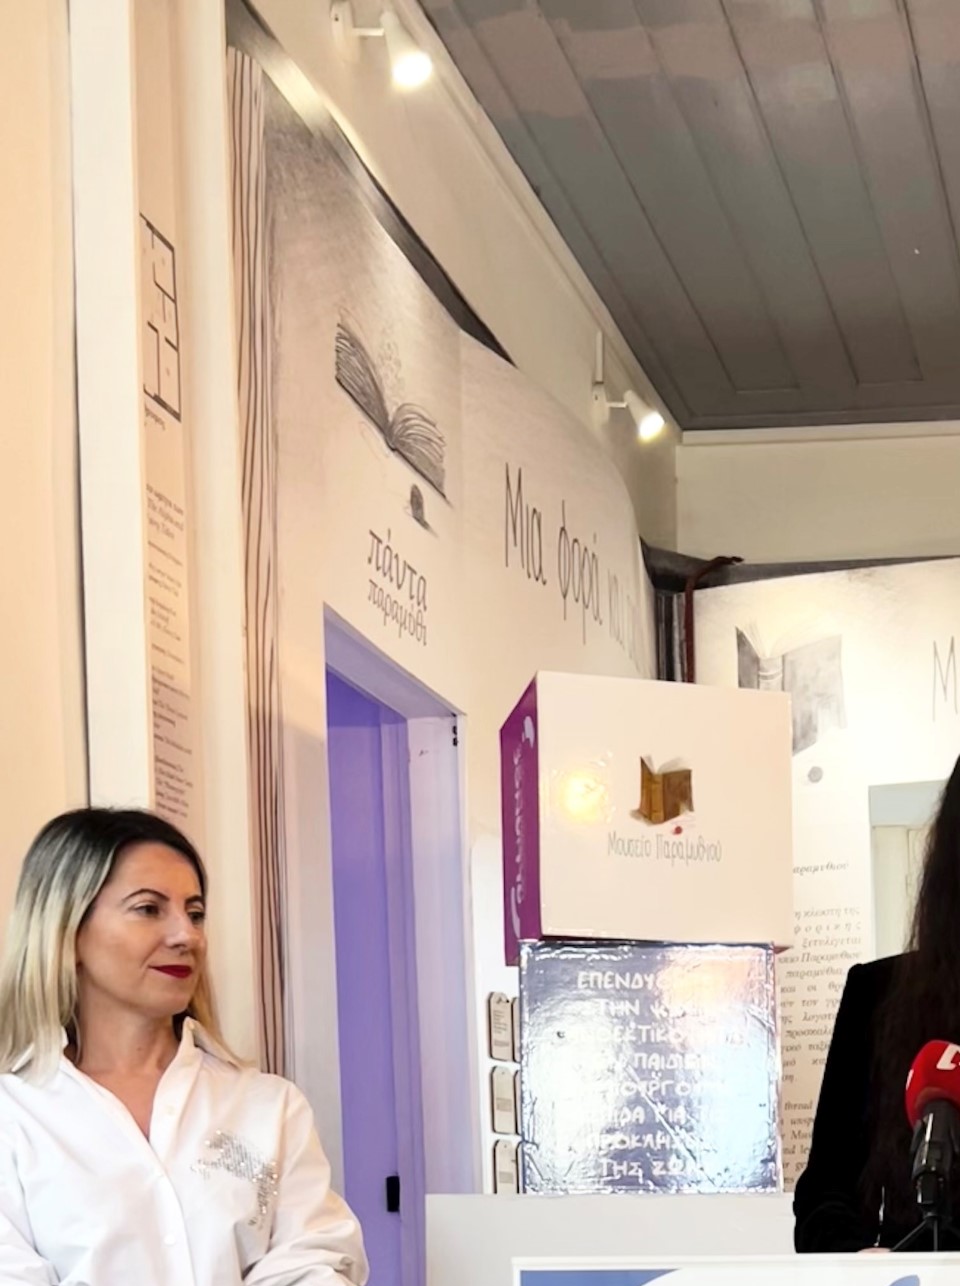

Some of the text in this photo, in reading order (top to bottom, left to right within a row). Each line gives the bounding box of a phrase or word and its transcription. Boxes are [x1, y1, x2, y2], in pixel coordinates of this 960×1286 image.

[367, 527, 428, 612] πάντα
[504, 462, 547, 586] Μια
[557, 499, 603, 646] φορά
